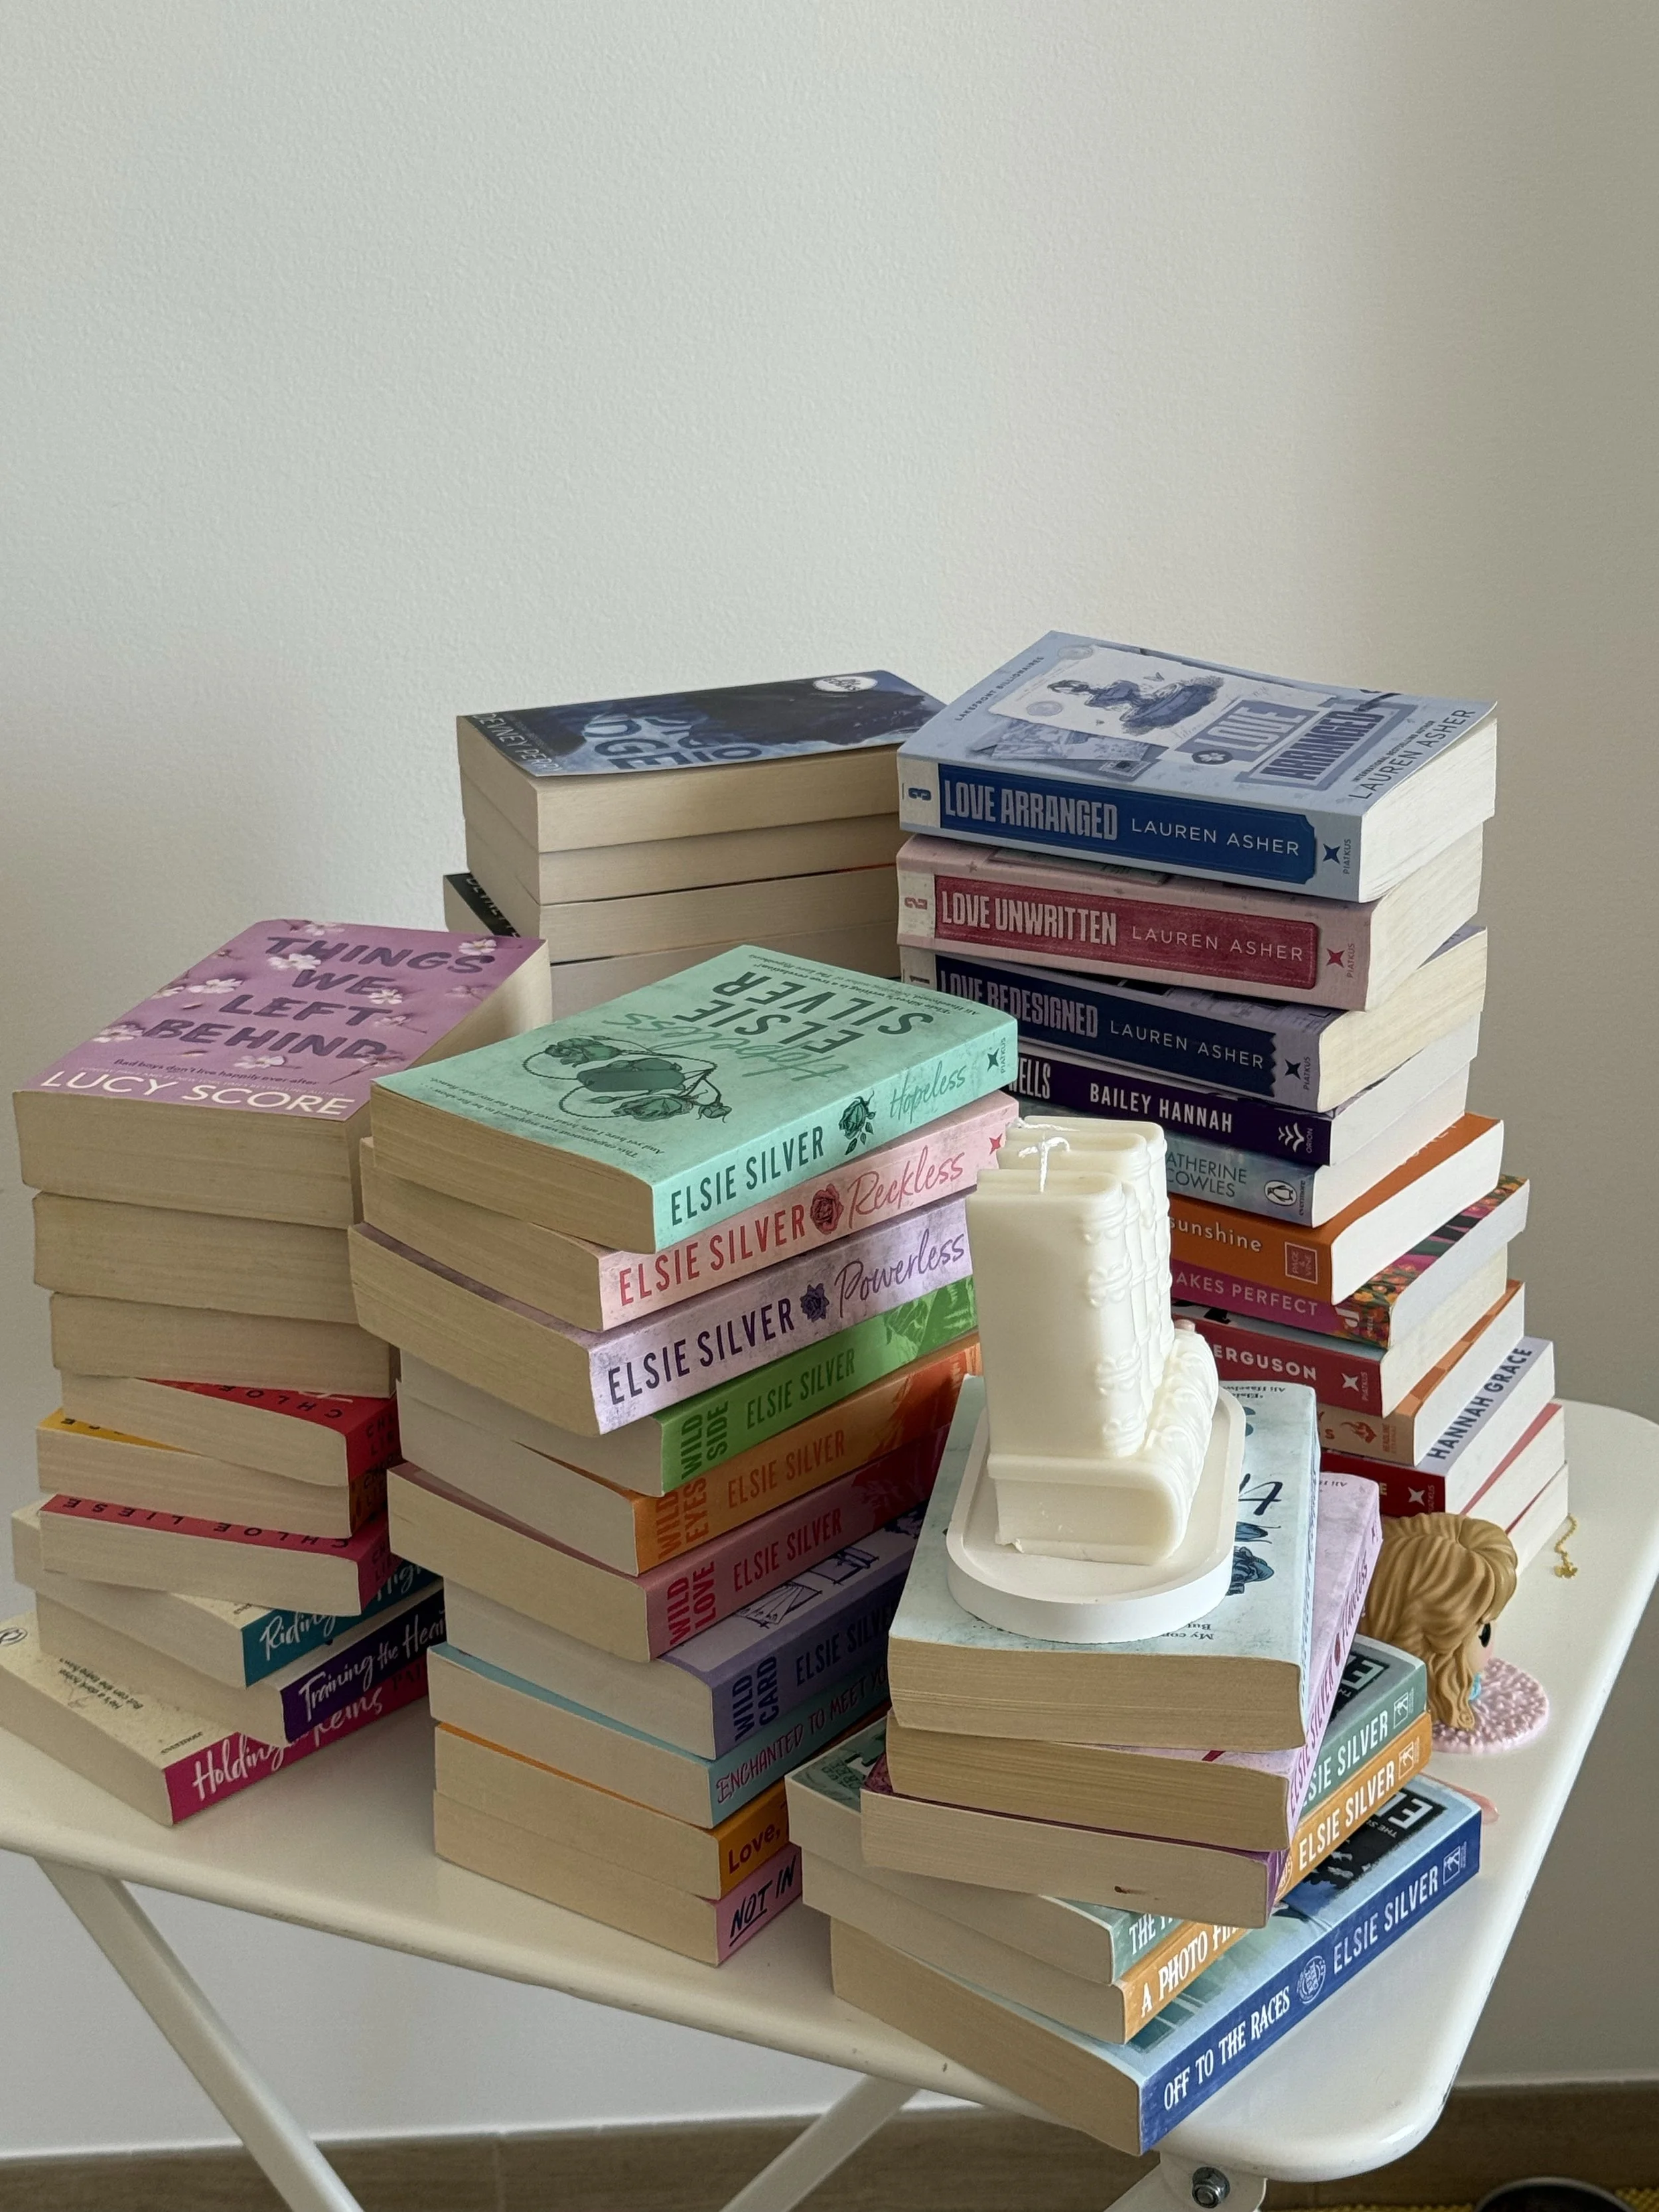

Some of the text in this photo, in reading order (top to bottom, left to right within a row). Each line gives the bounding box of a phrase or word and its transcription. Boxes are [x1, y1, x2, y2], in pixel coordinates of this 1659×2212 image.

[954, 656, 1045, 721] LAKEFRONT BILLIONAIRES
[472, 713, 533, 747] DEVNEY
[1194, 707, 1309, 751] LOVE
[1260, 711, 1385, 781] ARRANGED
[1348, 708, 1476, 800] LAUREN ASHER
[908, 786, 932, 802] 3
[944, 780, 1300, 857] LOVE ARRANGED LAUREN ASHER
[1342, 838, 1352, 875] PIATKUS
[265, 936, 496, 974] THINGS
[941, 890, 1304, 962] LOVE UNWRITTEN LAUREN ASHER
[292, 969, 399, 995] WE
[1346, 942, 1356, 978] PIATKUS
[219, 995, 393, 1028] LEFT
[672, 999, 865, 1054] ELSIE
[713, 971, 934, 1035] SILVER
[940, 970, 1263, 1070] LOVE REDESIGNED LAUREN ASHER
[137, 1062, 164, 1070] boys
[196, 1067, 217, 1076] live
[218, 1070, 259, 1080] happily
[143, 1019, 390, 1061] BEHIND
[603, 1012, 850, 1081] Hopeless
[999, 1036, 1009, 1075] PIATKUS
[40, 1070, 179, 1096] LUCY
[181, 1083, 356, 1116] SCORE
[1302, 1056, 1312, 1091] PIATKUS
[492, 1110, 540, 1127] supposed
[553, 1118, 579, 1129] head
[605, 1132, 628, 1142] here
[1089, 1082, 1153, 1115] BAILEY
[1158, 1098, 1232, 1134] HANNAH
[558, 1130, 616, 1149] engagement
[616, 1147, 639, 1159] This
[642, 1144, 665, 1155] And
[670, 1063, 967, 1227] ELSIE SILVER Hopeless
[1167, 1151, 1248, 1185] ATHERINE
[847, 1145, 965, 1228] Reckless
[618, 1204, 806, 1307] ELSIE SILVER
[1169, 1217, 1262, 1254] sunshine
[608, 1228, 965, 1406] ELSIE SILVER Powerless
[1176, 1272, 1319, 1317] AKES PERFECT
[747, 1347, 856, 1430] ELSIE SILVER
[1212, 1344, 1317, 1381] ERGUSON
[705, 1401, 729, 1461] SIDE
[1427, 1347, 1534, 1460] HANNAH GRACE
[681, 1412, 703, 1480] WILD
[727, 1428, 845, 1509] ELSIE SILVER
[63, 1497, 349, 1549] CHLOE LIESE
[657, 1491, 681, 1560] WILD
[685, 1477, 707, 1542] EYES
[733, 1508, 843, 1592] ELSIE SILVER
[666, 1576, 690, 1647] WILD
[691, 1561, 715, 1628] LOVE
[259, 1611, 336, 1661] Riding
[796, 1633, 841, 1686] ELSIE
[1190, 1631, 1214, 1640] My
[299, 1637, 399, 1722] Training the
[734, 1674, 755, 1741] WILD
[756, 1656, 779, 1726] CARD
[1309, 1654, 1335, 1749] SILVER
[192, 1731, 286, 1801] Holding
[715, 1722, 804, 1805] ENCHANTED
[808, 1705, 826, 1735] TO
[830, 1673, 867, 1720] MEET
[1302, 1760, 1333, 1809] SIE
[1337, 1708, 1389, 1776] SILVER
[1299, 1807, 1340, 1872] ELSIE
[1344, 1759, 1395, 1825] SILVER
[729, 1822, 782, 1874] Love,
[729, 1860, 796, 1938] NOT IN
[1129, 1913, 1157, 1955] THE
[1141, 1930, 1208, 2018] A PHOTO
[1163, 1866, 1439, 2110] OFF TO THE RACES ELSIE SILVER
